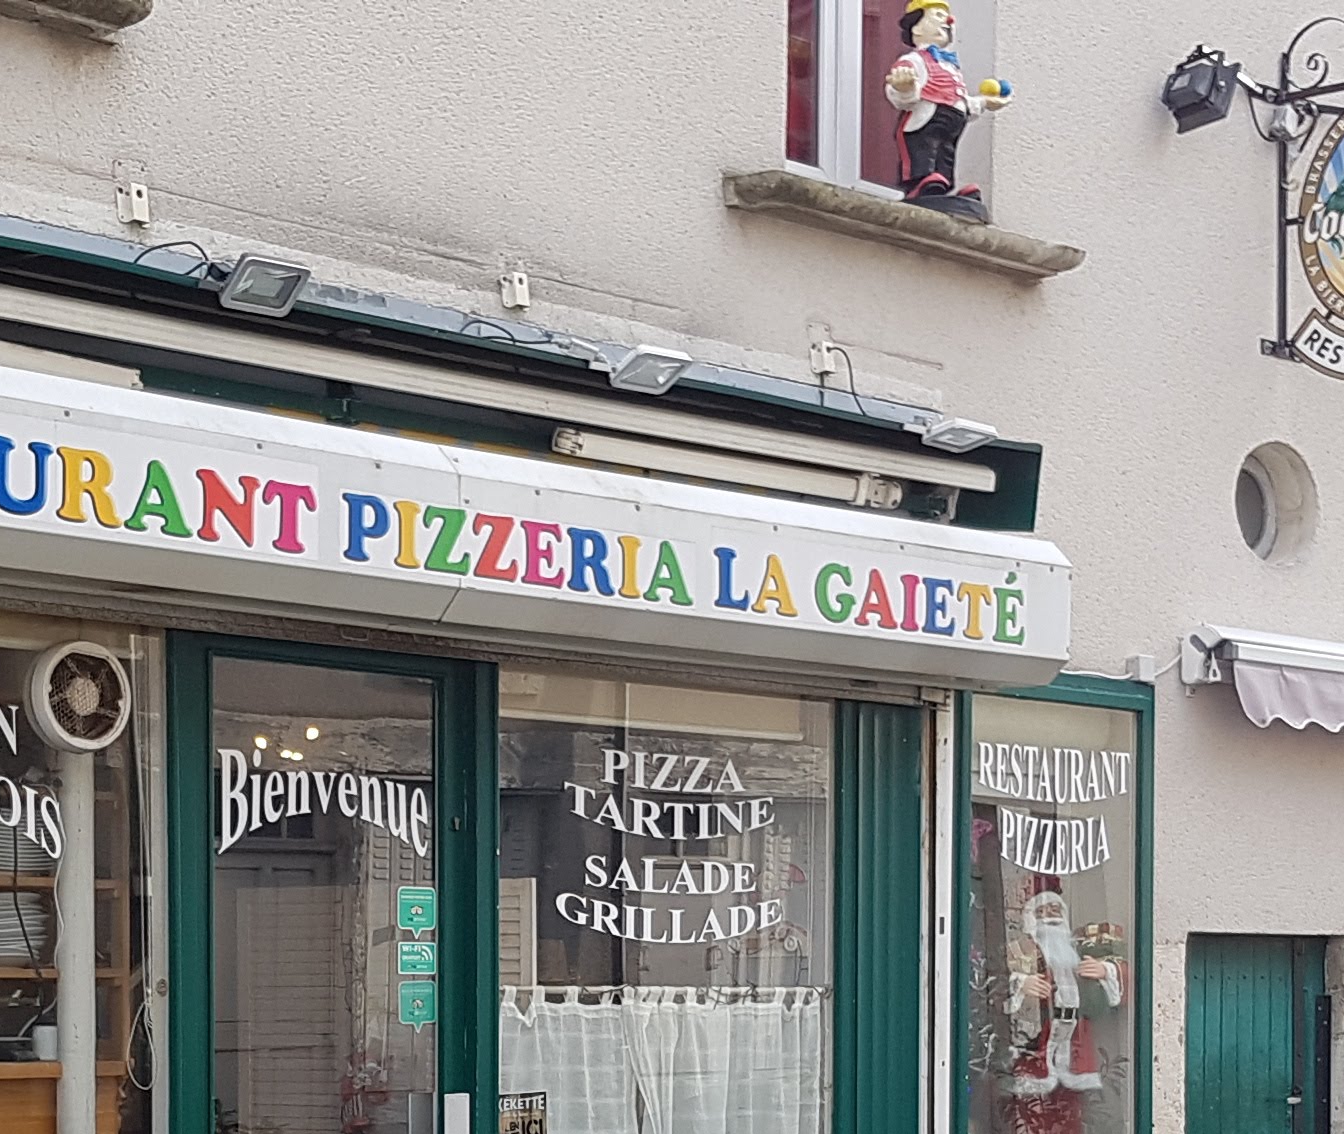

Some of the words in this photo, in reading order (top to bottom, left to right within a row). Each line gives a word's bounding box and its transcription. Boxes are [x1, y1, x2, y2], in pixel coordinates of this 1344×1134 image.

[1305, 254, 1320, 276] LA
[342, 491, 693, 608] PIZZERIA
[714, 545, 798, 618] LA
[814, 561, 1026, 645] GAIETÉ
[599, 748, 746, 794] PIZZA
[978, 741, 1131, 804] RESTAURANT
[217, 748, 429, 858] Bienvenue
[563, 781, 776, 840] TARTINE
[1000, 807, 1111, 875] PIZZERIA
[584, 855, 757, 895] SALADE
[556, 892, 783, 944] GRILLADE
